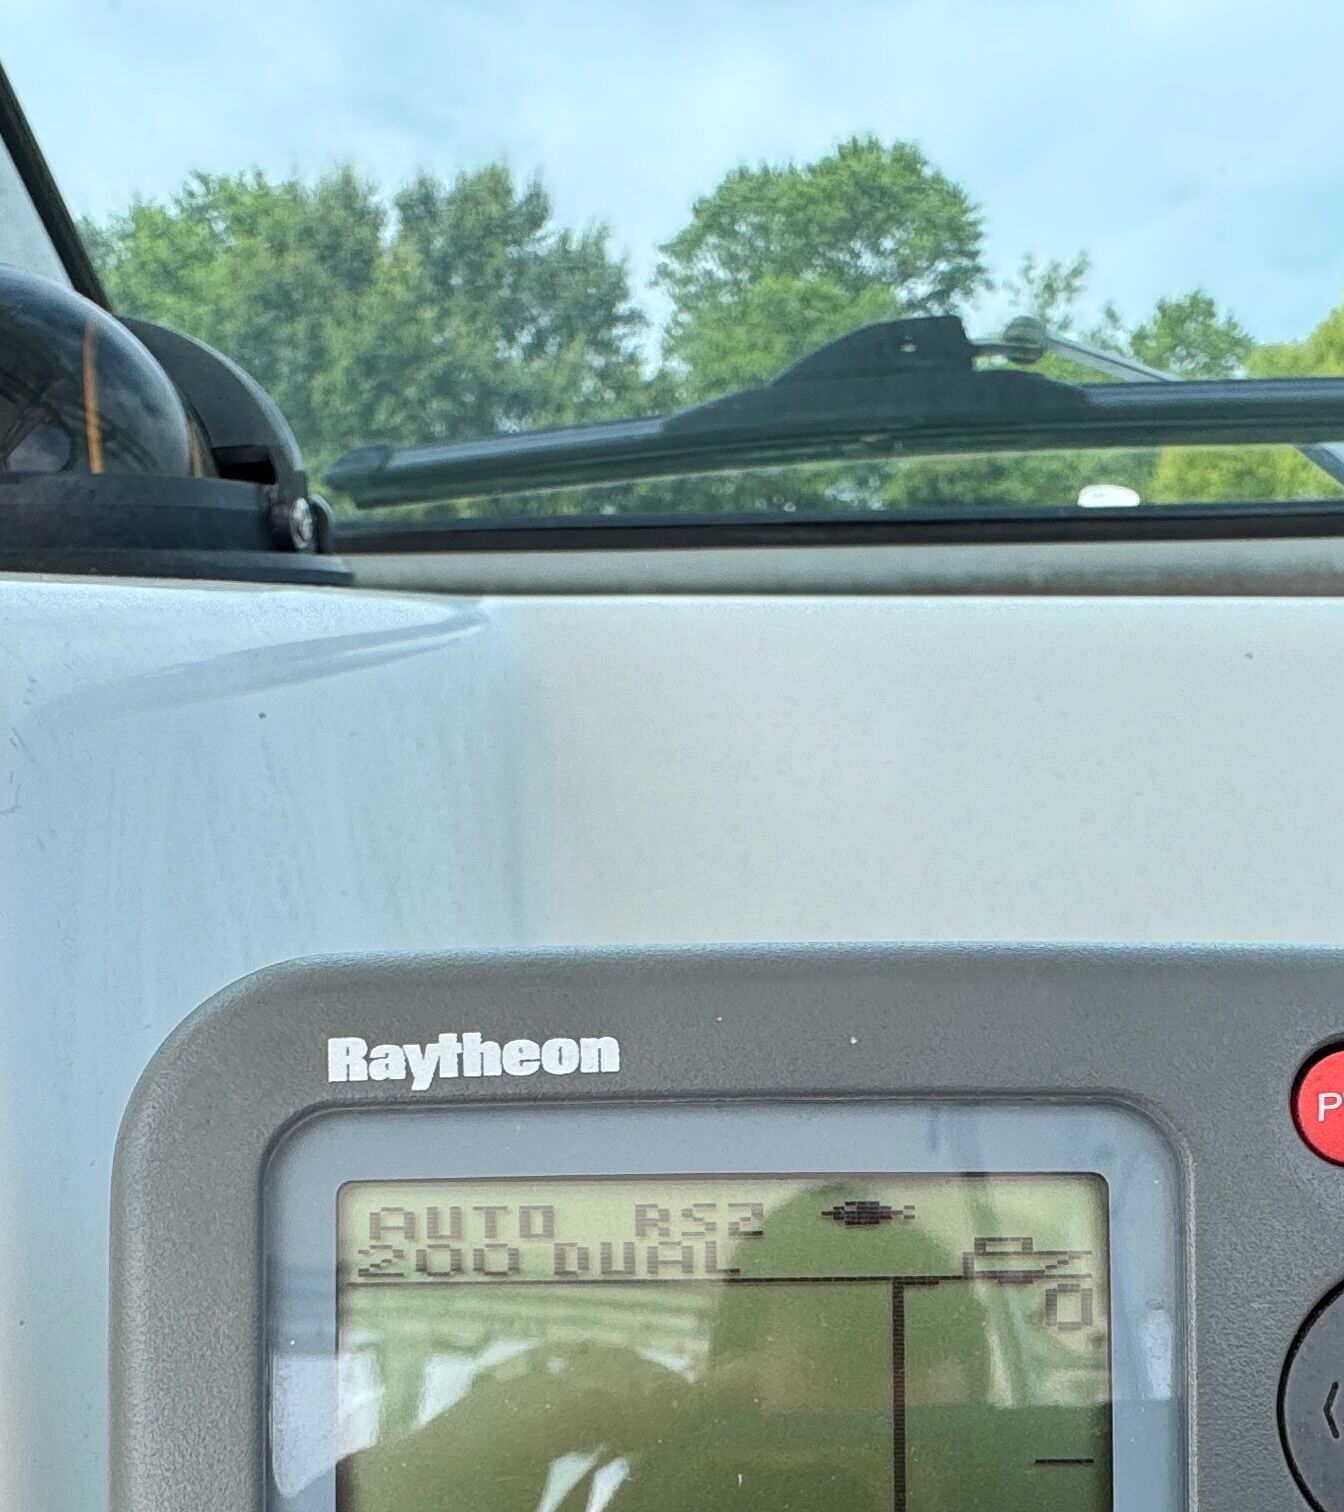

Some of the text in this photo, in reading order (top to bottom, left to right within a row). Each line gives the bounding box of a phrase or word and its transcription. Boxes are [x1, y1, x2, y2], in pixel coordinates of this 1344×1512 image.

[327, 1032, 620, 1091] Raytheon
[369, 1205, 555, 1241] AUTO
[358, 1240, 741, 1277] 200 DUAL
